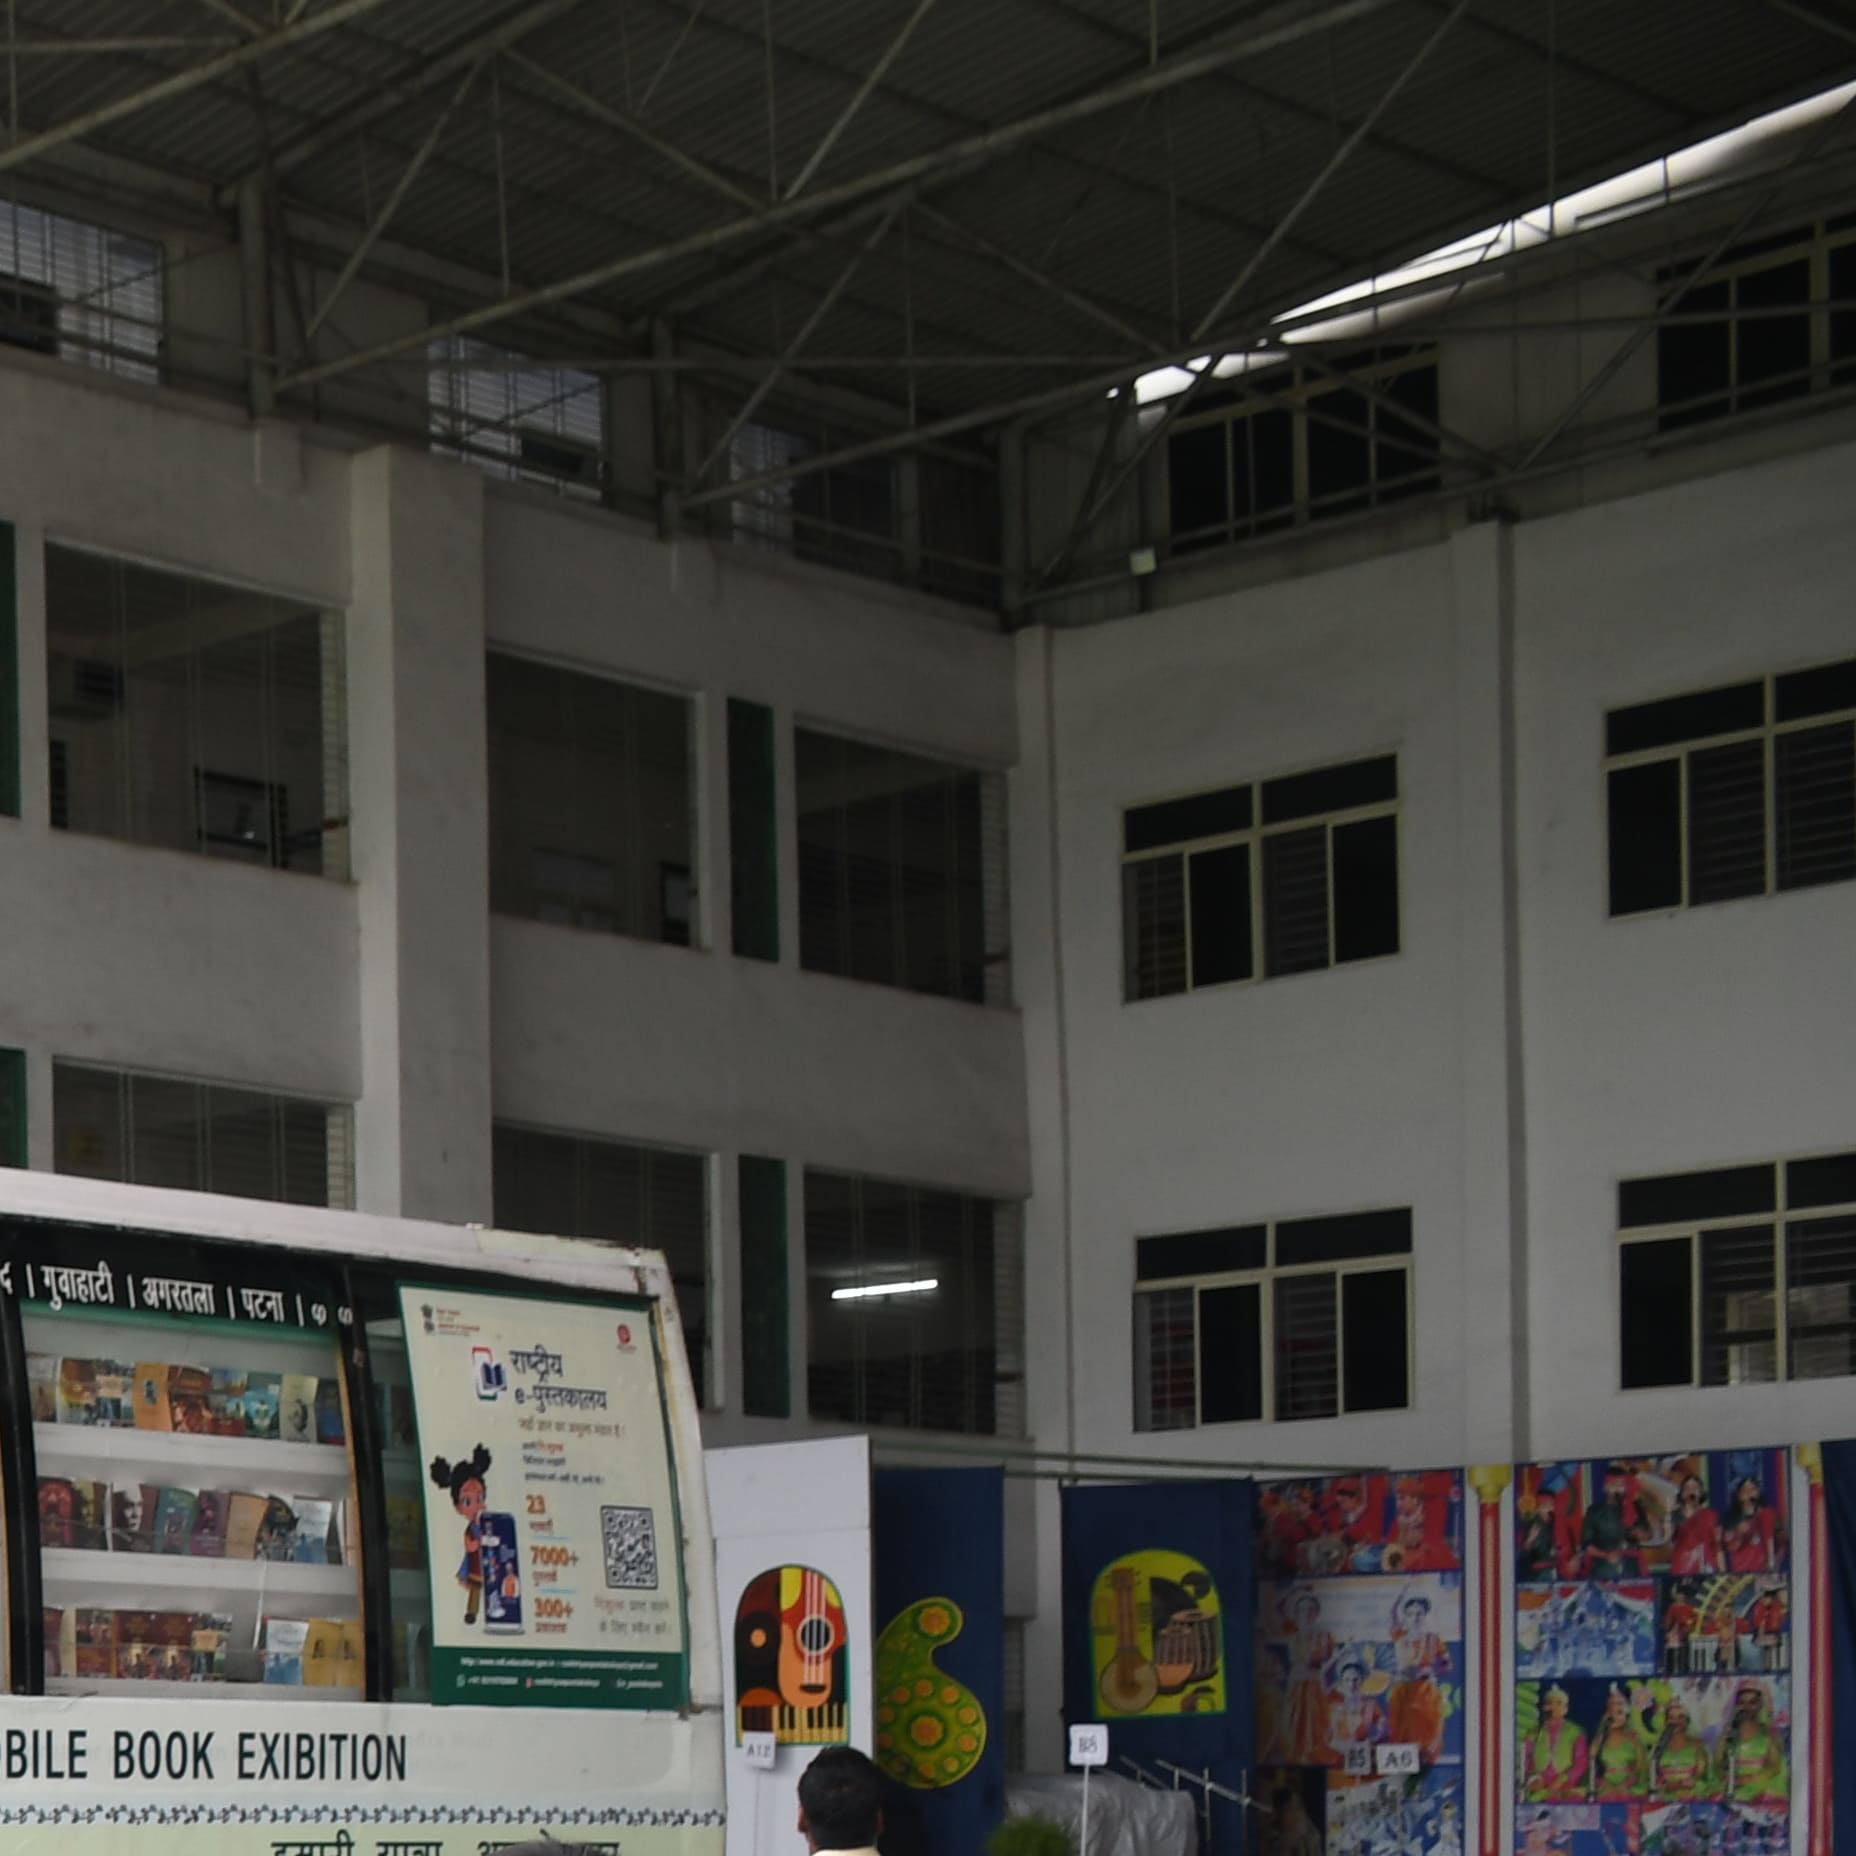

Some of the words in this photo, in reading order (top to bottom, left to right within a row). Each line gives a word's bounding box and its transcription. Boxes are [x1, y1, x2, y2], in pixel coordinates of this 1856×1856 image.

[40, 1260, 115, 1312] गुवाहाटी
[141, 1276, 216, 1315] अगरतला
[240, 1288, 286, 1322] पटना
[509, 1344, 563, 1384] राष्ट्रीय
[526, 1494, 545, 1514] 23
[530, 1545, 579, 1566] 7000+
[534, 1598, 574, 1618] 300+
[113, 1730, 215, 1779] BOOK
[237, 1732, 407, 1781] EXIBITION
[1385, 1751, 1412, 1767] A6
